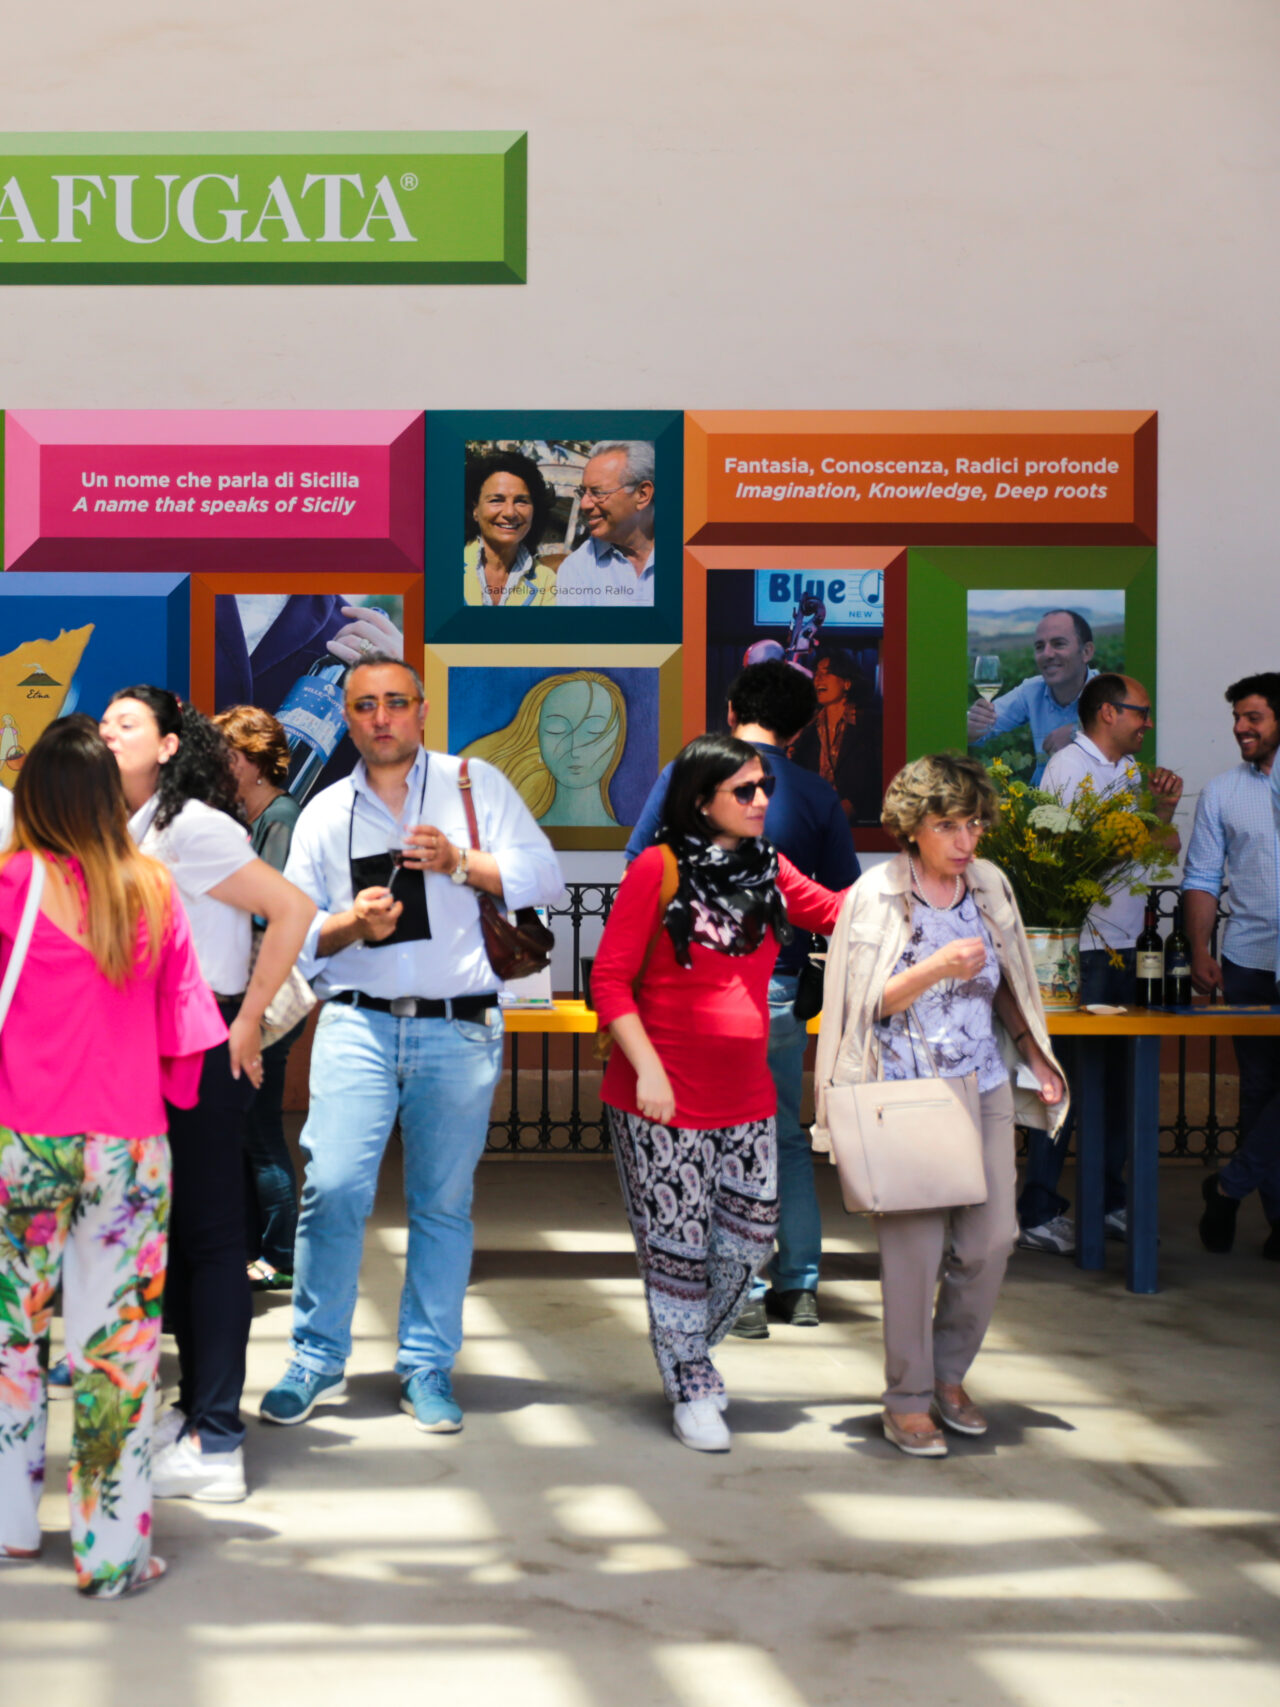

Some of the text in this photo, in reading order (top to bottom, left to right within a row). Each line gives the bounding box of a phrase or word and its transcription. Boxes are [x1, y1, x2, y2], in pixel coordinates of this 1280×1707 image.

[724, 457, 1120, 477] Fantasia, Conoscenza, Radici profonde
[81, 472, 360, 490] Un nome che parla di Sicilia
[735, 482, 1108, 501] Imagination, Knowledge, Deep roots
[72, 496, 357, 516] A name that speaks of Sicily
[549, 585, 602, 595] Giacomo
[605, 585, 634, 595] Rallo
[769, 573, 846, 603] Blue
[26, 689, 50, 699] Etna
